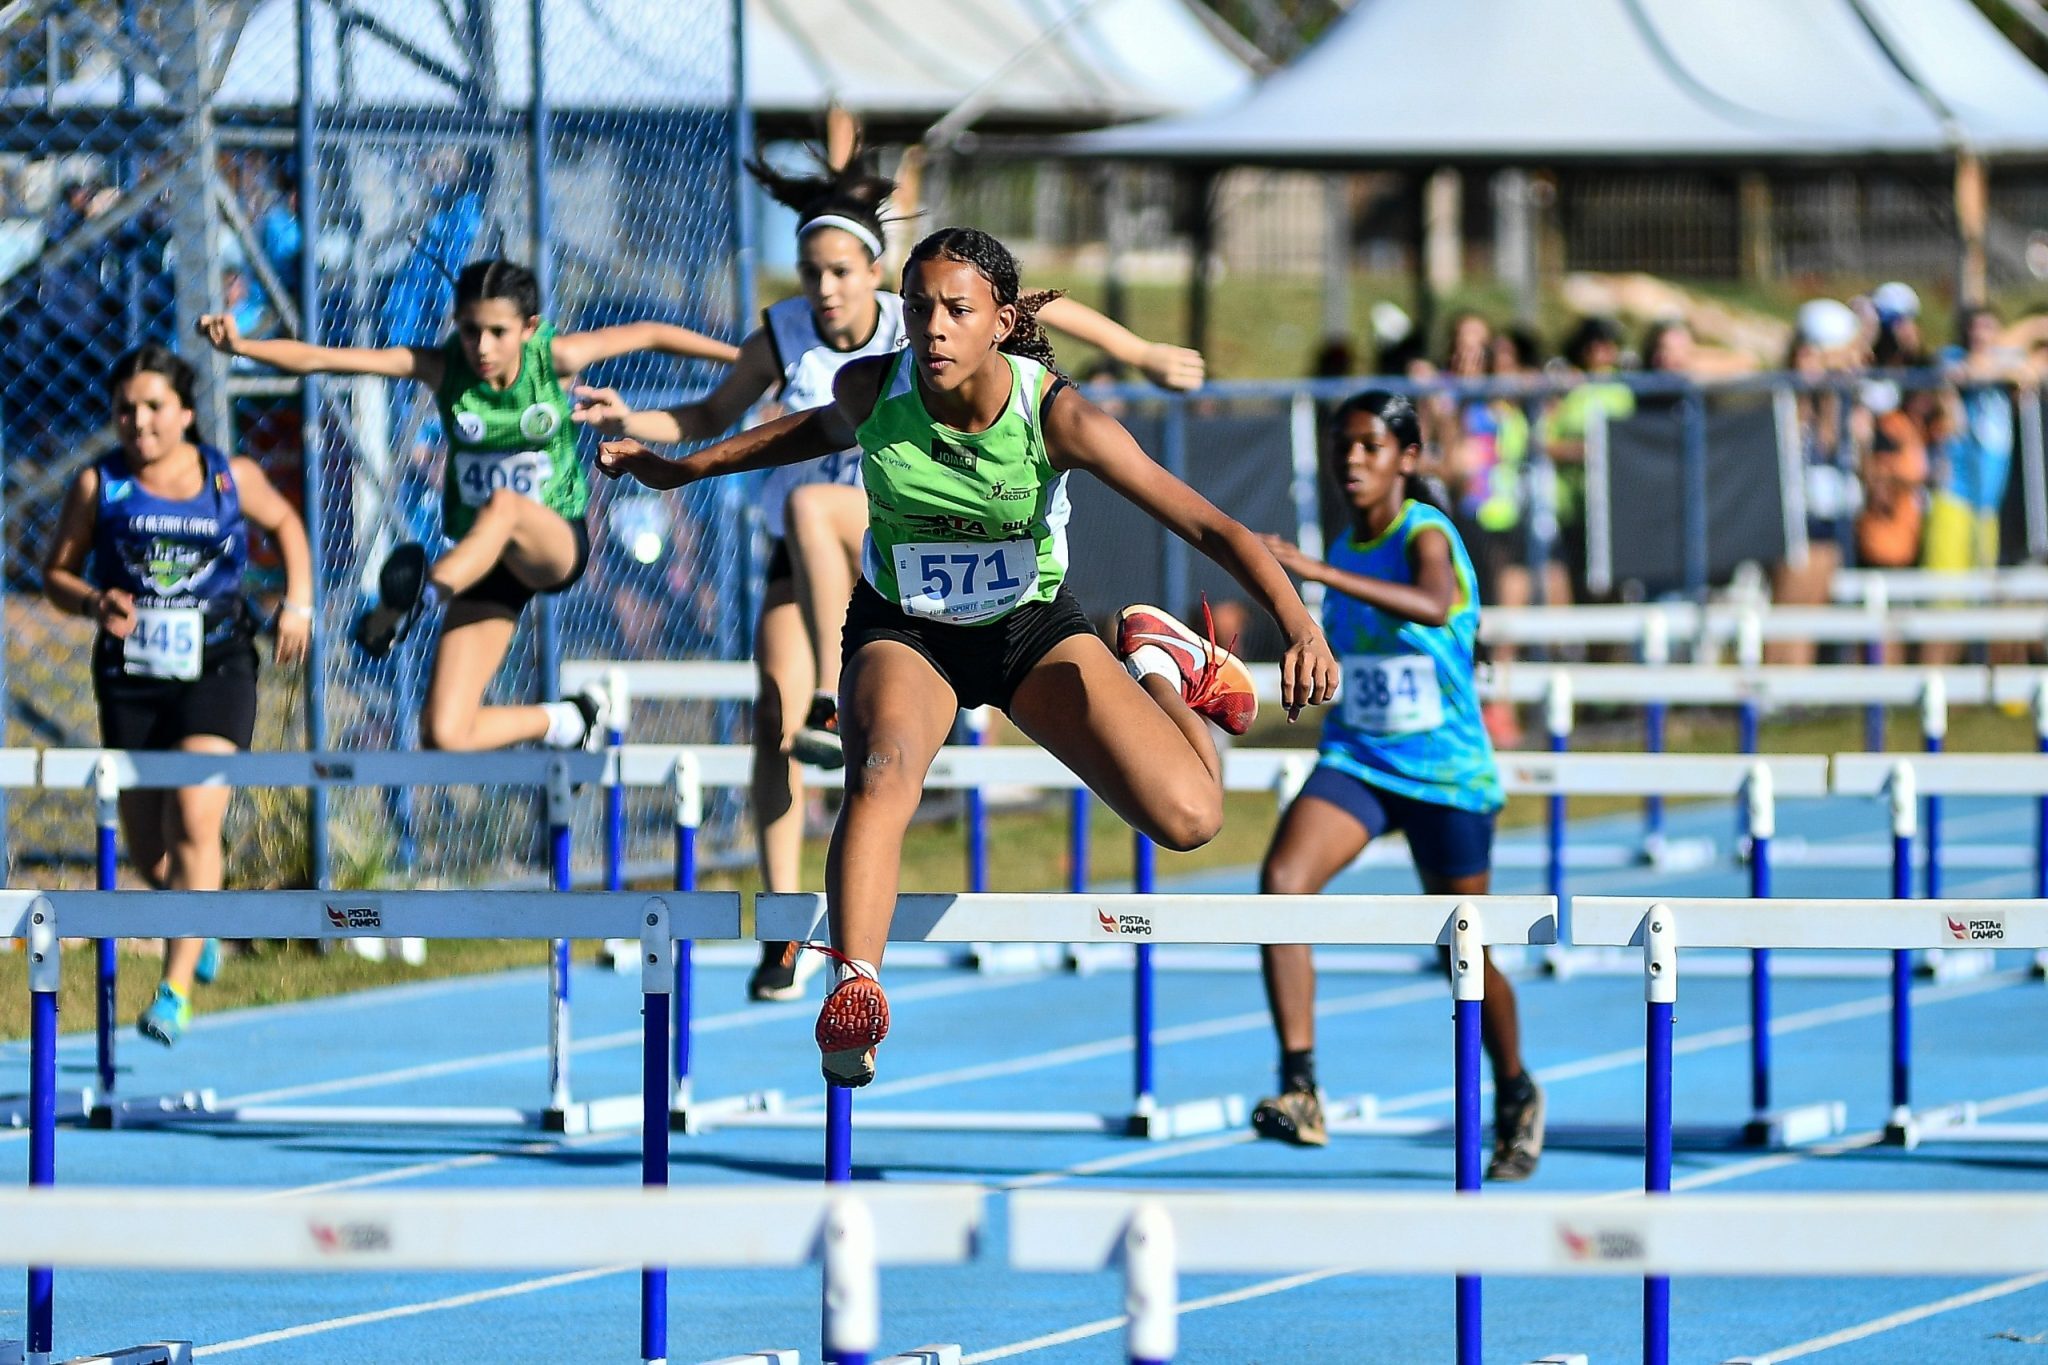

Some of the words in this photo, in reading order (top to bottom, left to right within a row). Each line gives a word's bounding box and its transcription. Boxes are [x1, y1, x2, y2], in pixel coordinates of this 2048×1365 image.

[463, 462, 536, 494] 406
[920, 549, 1021, 601] 571
[134, 618, 193, 655] 445
[1352, 666, 1418, 708] 384
[347, 909, 372, 918] PISTA
[349, 918, 381, 928] CAMPO
[1119, 914, 1145, 925] PISTA
[1969, 920, 1996, 930] PISTA
[1120, 924, 1152, 935] CAMPO
[1971, 930, 2004, 940] CAMPO
